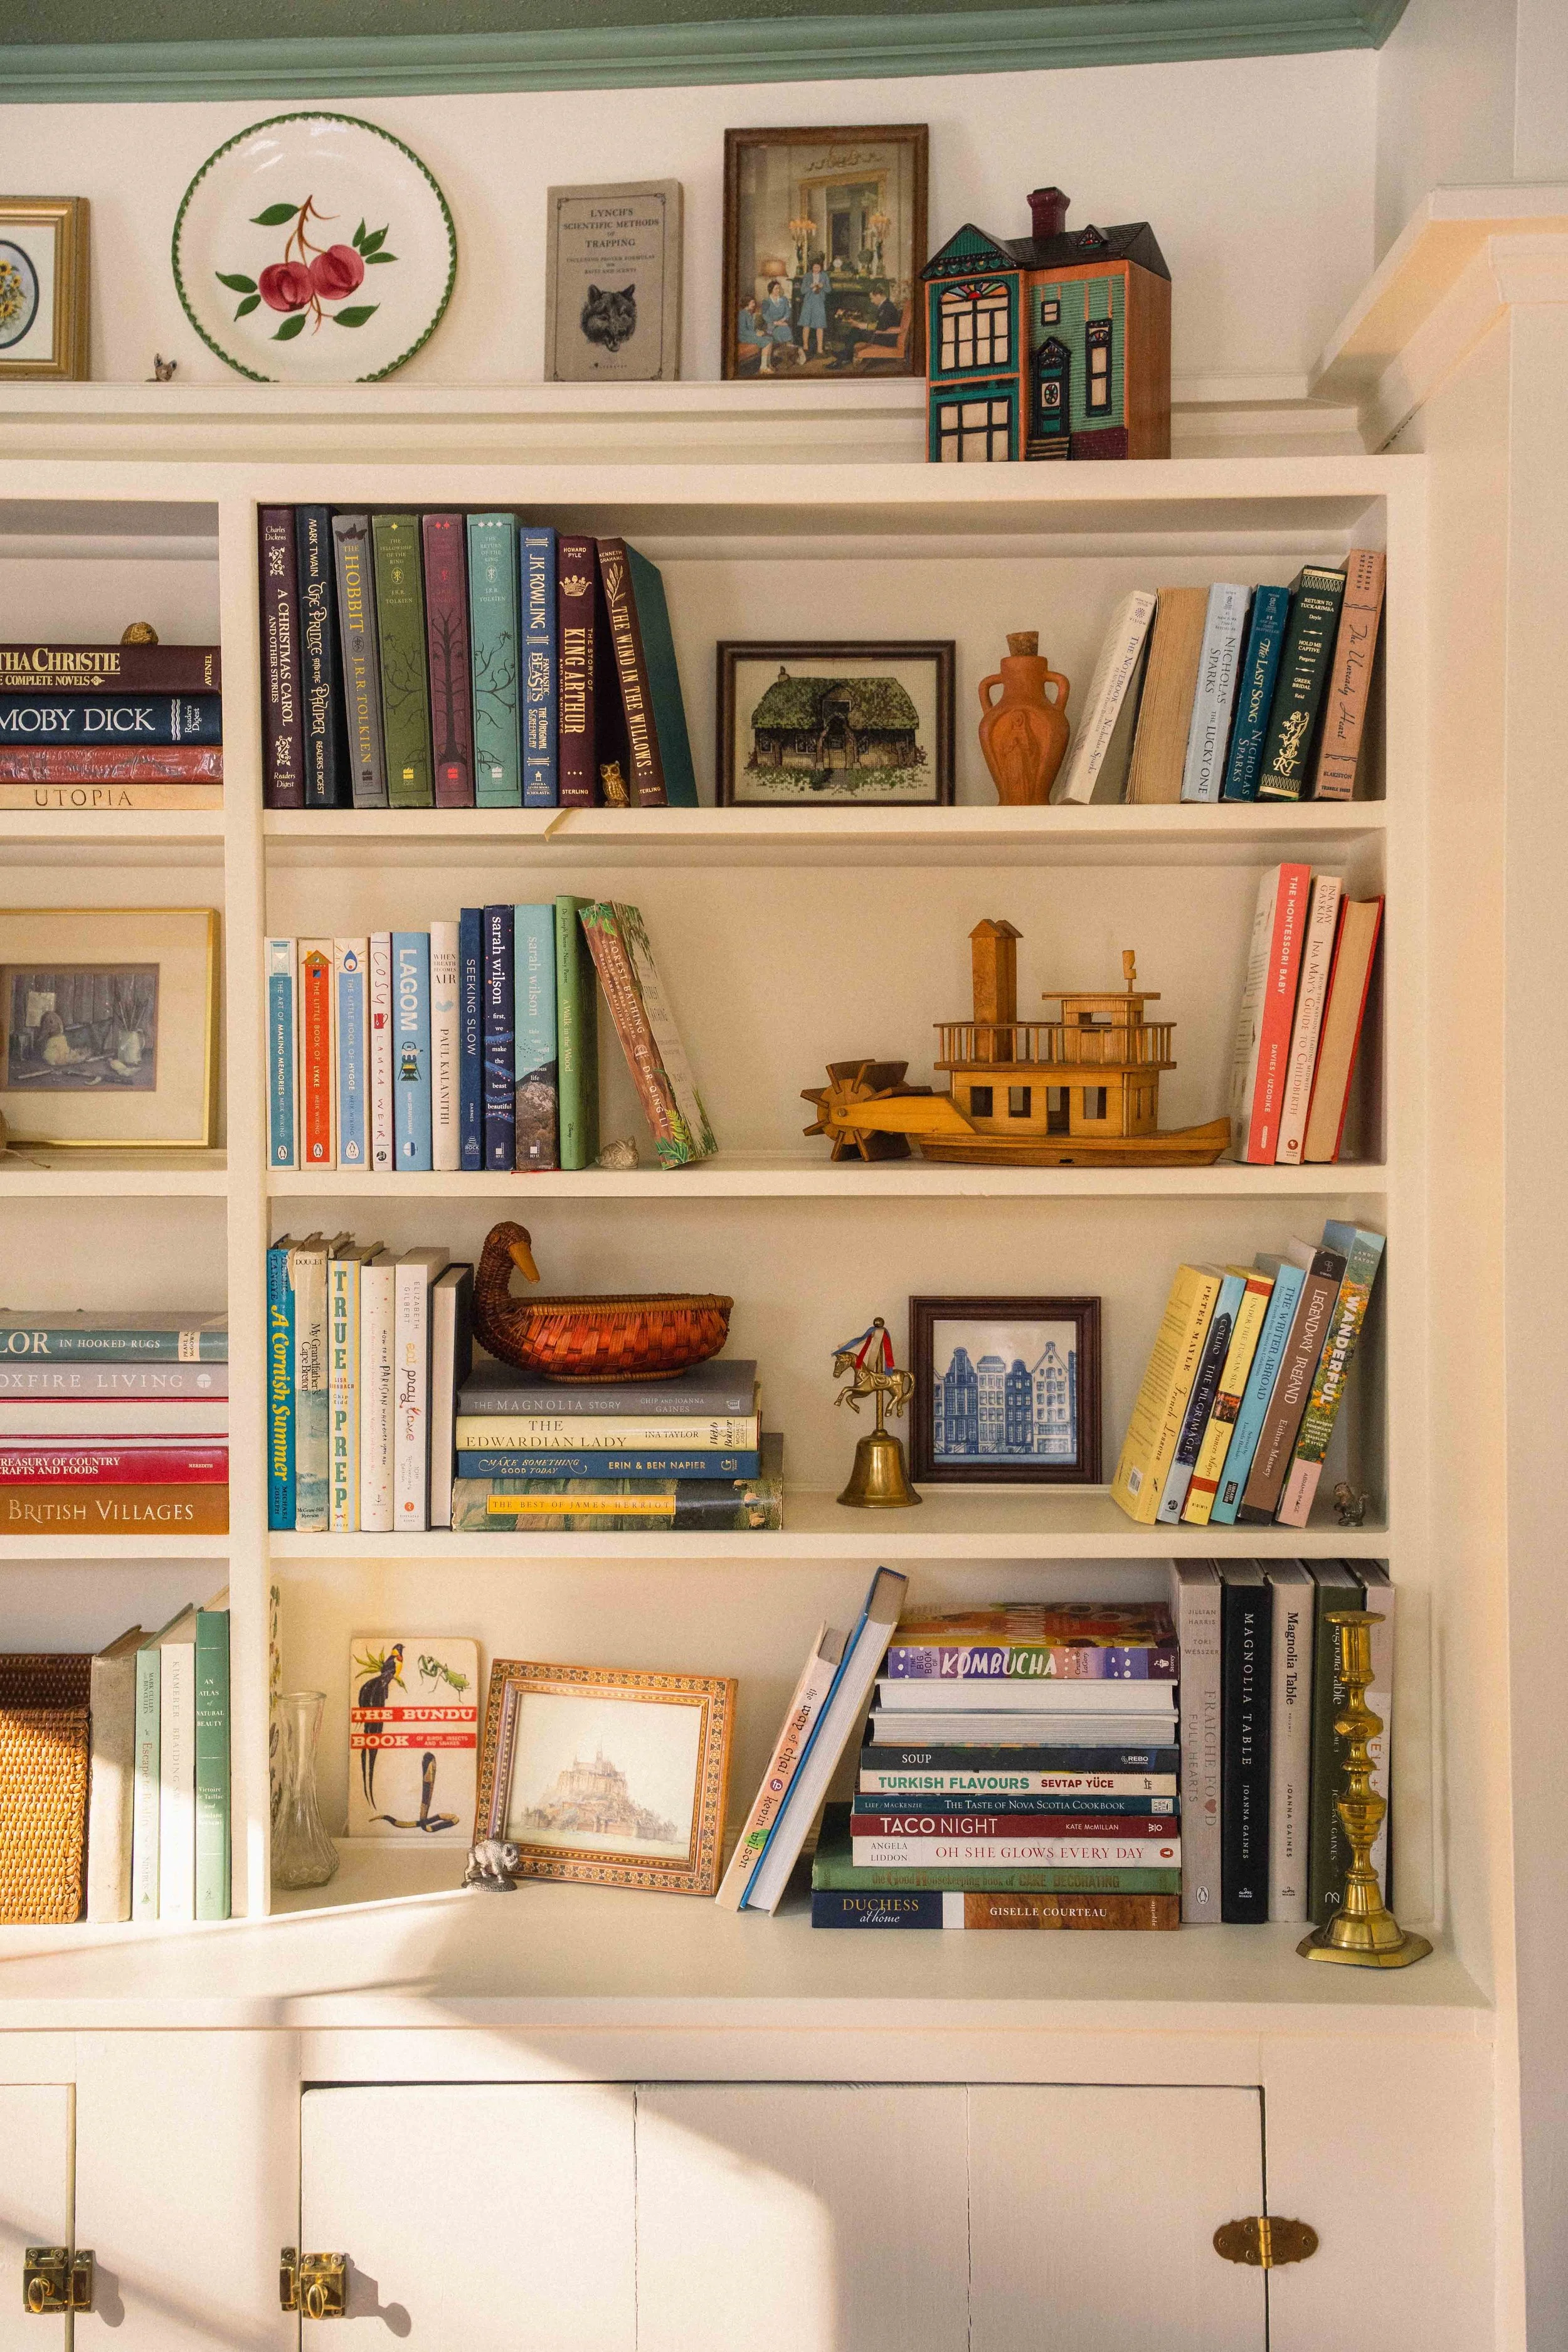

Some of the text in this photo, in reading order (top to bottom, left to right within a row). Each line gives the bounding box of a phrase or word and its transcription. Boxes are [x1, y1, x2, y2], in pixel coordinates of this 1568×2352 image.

[563, 219, 659, 230] SCIENTIFIC METHODS
[591, 208, 633, 217] LYNCH'S
[586, 238, 635, 248] TRAPPING
[309, 518, 318, 576] MARK TWAIN
[345, 556, 364, 632] HOBBIT
[529, 573, 545, 629] ROWLING
[1301, 603, 1335, 612] TUCKARIMBA
[1130, 617, 1146, 625] VISION
[55, 675, 90, 686] NOVELS
[204, 654, 212, 686] AVENEL
[278, 603, 293, 726] CHRISTMAS CAROL
[564, 628, 585, 734] KING ARTHUR
[1111, 657, 1133, 702] NOTEBOOK
[1206, 649, 1221, 694] SPARKS
[1217, 637, 1236, 704] NICHOLAS
[617, 633, 652, 768] WIND WILLOWS
[84, 709, 155, 731] DICK
[356, 694, 371, 763] TOLKIEN
[1204, 727, 1216, 766] LUCKY
[1232, 730, 1262, 795] NICHOLAS SPARKS
[34, 789, 133, 807] UTOPIA
[1198, 769, 1211, 793] ONE
[1317, 885, 1328, 923] GASKIN
[1325, 905, 1334, 924] MAY
[492, 916, 505, 1005] sarah wilson
[1278, 899, 1296, 994] MONTESSORI BABY
[400, 950, 418, 1031] LAGOM
[434, 975, 456, 984] AIR
[529, 937, 541, 1016] sarah wilson
[609, 940, 627, 980] FOREST
[623, 986, 644, 1033] BATHING
[467, 959, 476, 1056] SEEKING SLOW
[440, 1029, 449, 1125] PAUL KALANITHI
[1264, 1044, 1278, 1112] DAVIES UZODIKE
[1290, 1053, 1307, 1115] CHILDBIRTH
[78, 1340, 160, 1348] HOOKED RUGS
[1184, 1285, 1212, 1371] PETER MAYLE
[1257, 1287, 1296, 1400] THE WRITER ABROAD
[300, 1342, 311, 1392] Cape Breton
[310, 1339, 321, 1394] Grandfather's
[1320, 1296, 1360, 1405] WANDERFUL
[97, 1375, 183, 1387] LIVING
[1185, 1318, 1228, 1456] COELHO PILGRIMAGE
[1263, 1289, 1328, 1478] LEGENDARY IRELAND Eithne Massey
[272, 1333, 291, 1481] Cornish Summer
[497, 1401, 582, 1409] MAGNOLIA
[467, 1437, 627, 1446] EDWARDIAN LADY
[63, 1466, 98, 1475] FOODS
[69, 1458, 120, 1466] COUNTRY
[95, 1500, 193, 1520] VILLAGES
[941, 1651, 1056, 1675] KOMBUCHA
[1242, 1613, 1254, 1765] MAGNOLIA TABLE
[352, 1709, 474, 1720] THE BUNDU
[352, 1735, 409, 1746] BOOK
[902, 1754, 931, 1764] SOUP
[879, 1777, 1114, 1789] TURKISH FLAVOURS SEVTAP YÜCE
[965, 1800, 1125, 1809] TASTE NOVA SCOTIA COOKBOOK
[880, 1818, 935, 1833] TACO
[941, 1818, 998, 1834] NIGHT
[936, 1847, 1144, 1859] OH SHE GLOWS EVERY DAY
[842, 1899, 919, 1911] DUCHESS
[990, 1907, 1106, 1917] GISELLE COURTEAU
